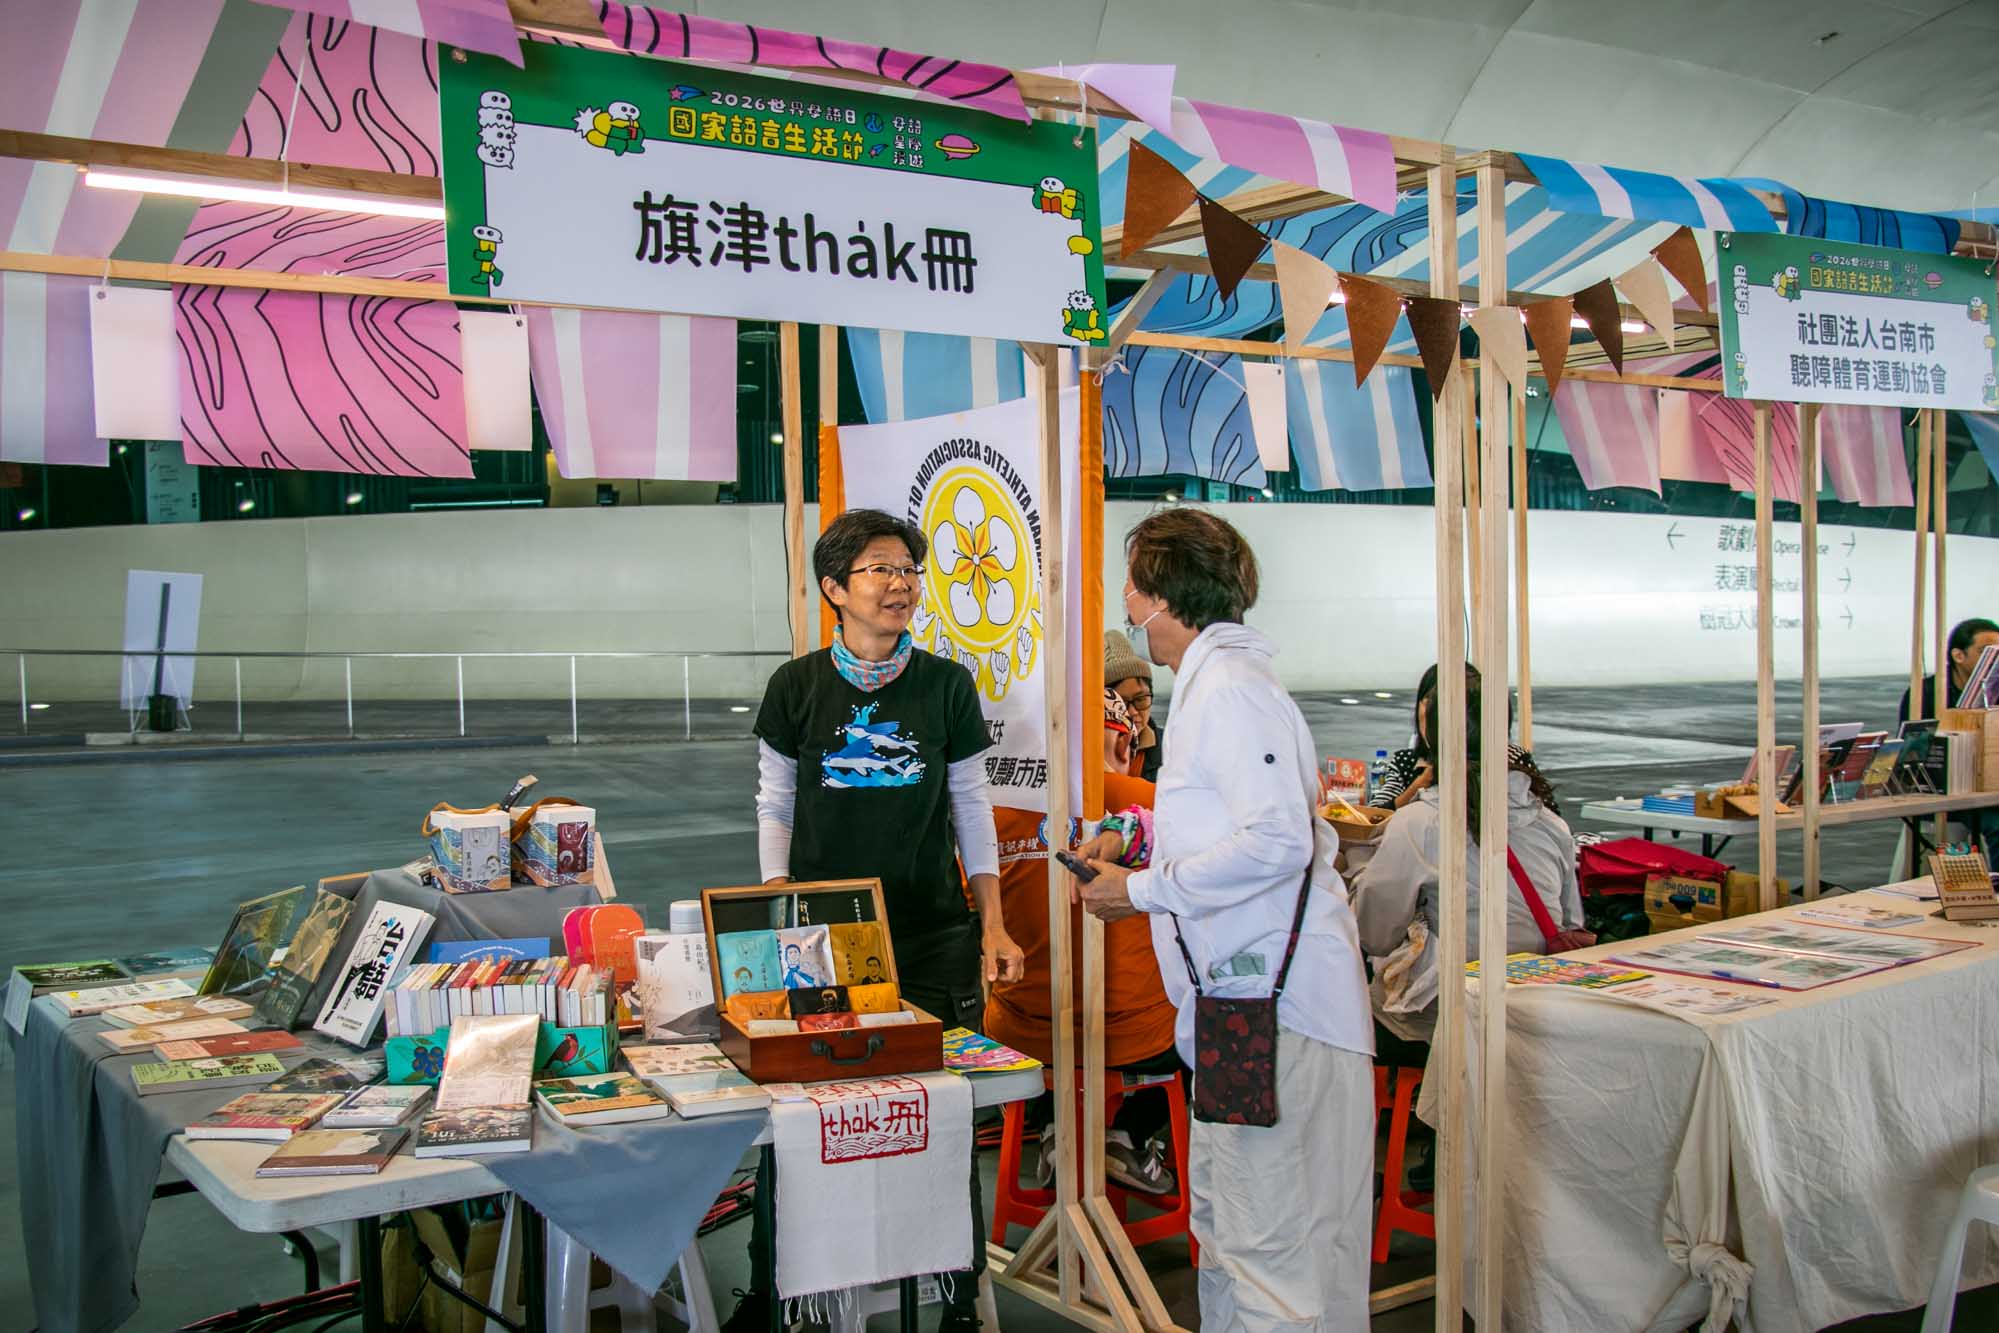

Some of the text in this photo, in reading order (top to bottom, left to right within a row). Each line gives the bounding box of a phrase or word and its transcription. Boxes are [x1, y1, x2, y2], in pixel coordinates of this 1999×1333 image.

[711, 91, 857, 124] 2026世界母語日
[668, 106, 864, 161] 國家語言生活節
[1798, 312, 1935, 354] 社團法人台南市
[1790, 353, 1947, 394] 聽障體育運動協會
